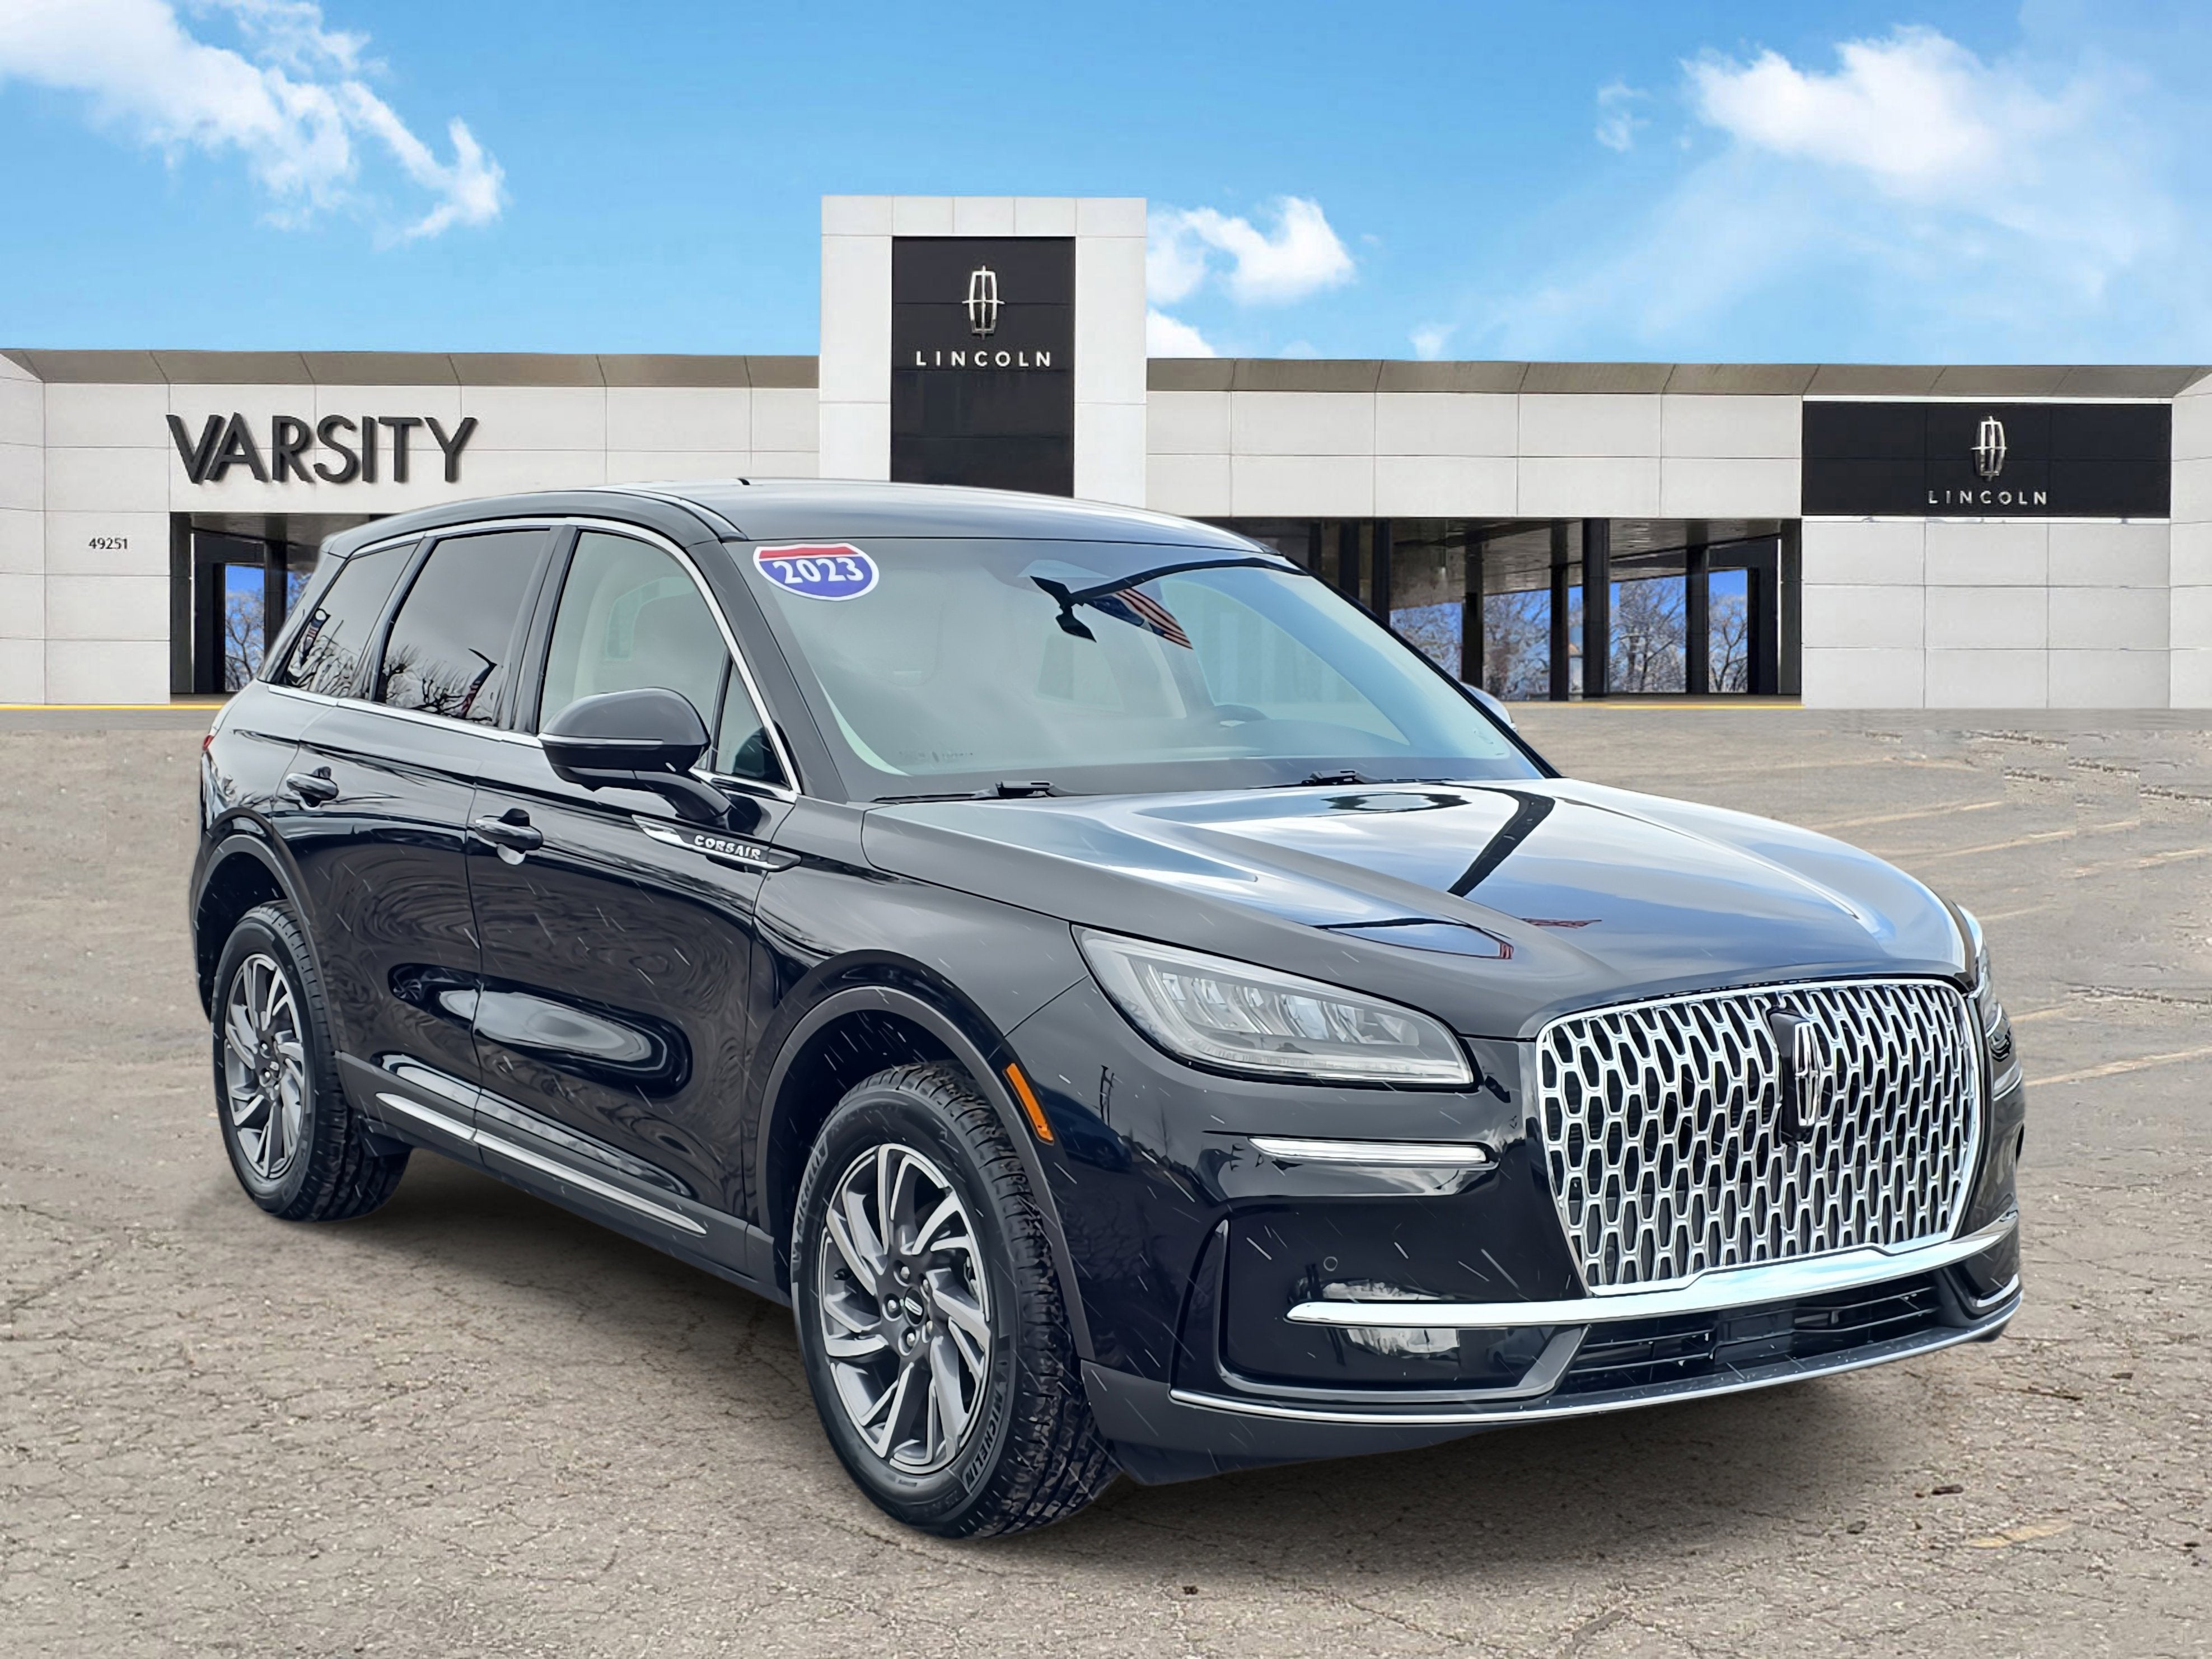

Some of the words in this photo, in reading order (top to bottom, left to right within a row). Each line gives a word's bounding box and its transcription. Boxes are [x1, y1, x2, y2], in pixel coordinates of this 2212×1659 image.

[916, 351, 1050, 367] LINCOLN
[166, 412, 478, 484] VARSITY
[1928, 490, 2047, 504] LINCOLN
[88, 537, 128, 549] 49251
[773, 557, 864, 583] 2023
[694, 834, 761, 860] CORSAIR
[964, 1387, 1003, 1488] MICHELIN
